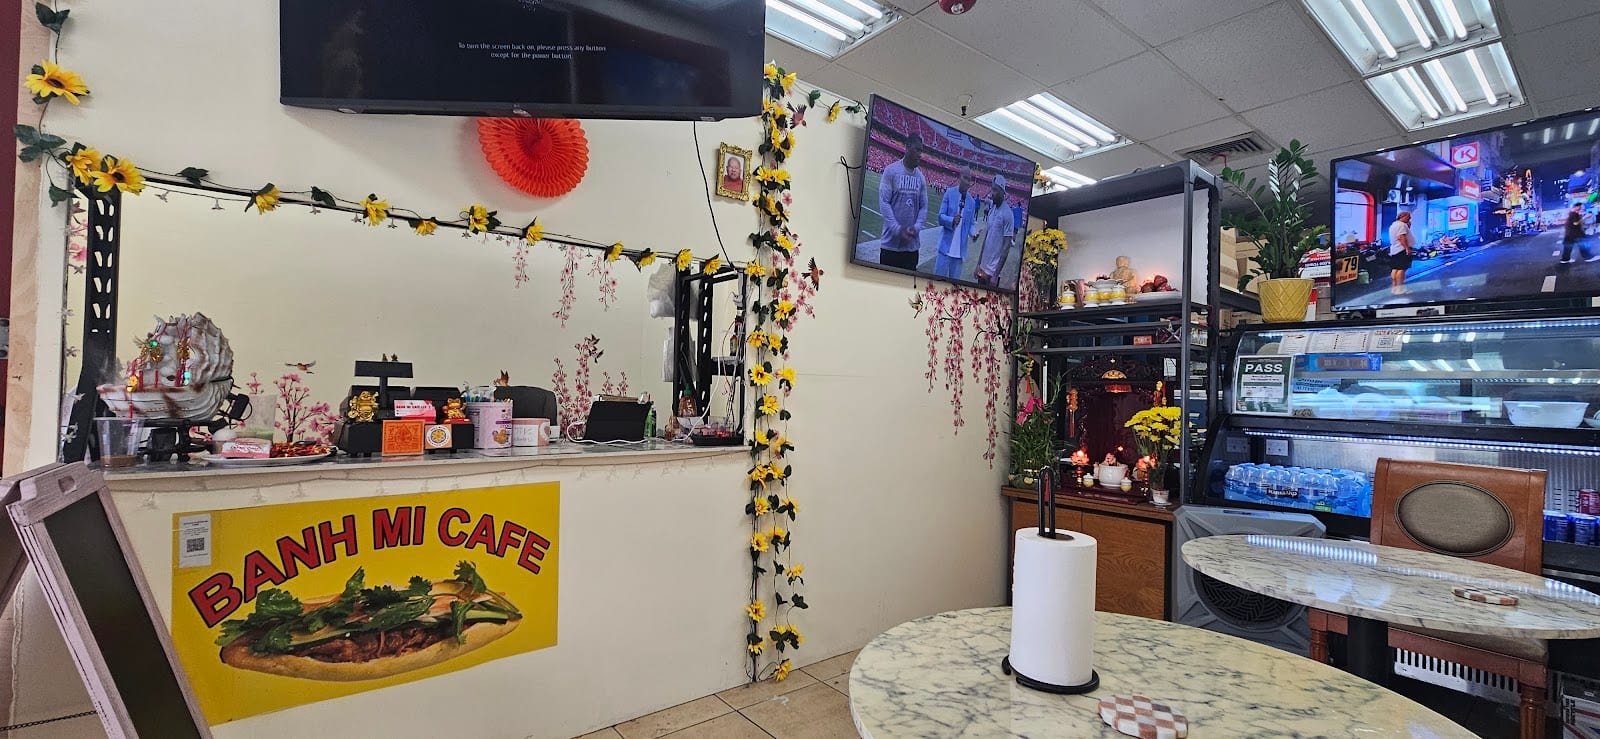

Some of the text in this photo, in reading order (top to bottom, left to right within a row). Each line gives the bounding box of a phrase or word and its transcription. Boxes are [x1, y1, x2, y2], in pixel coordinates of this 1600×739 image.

[467, 42, 479, 50] turn
[480, 42, 490, 50] the
[536, 44, 556, 52] please
[573, 45, 584, 53] any
[1244, 363, 1283, 373] PASS
[187, 506, 551, 628] BANH MI CAFE
